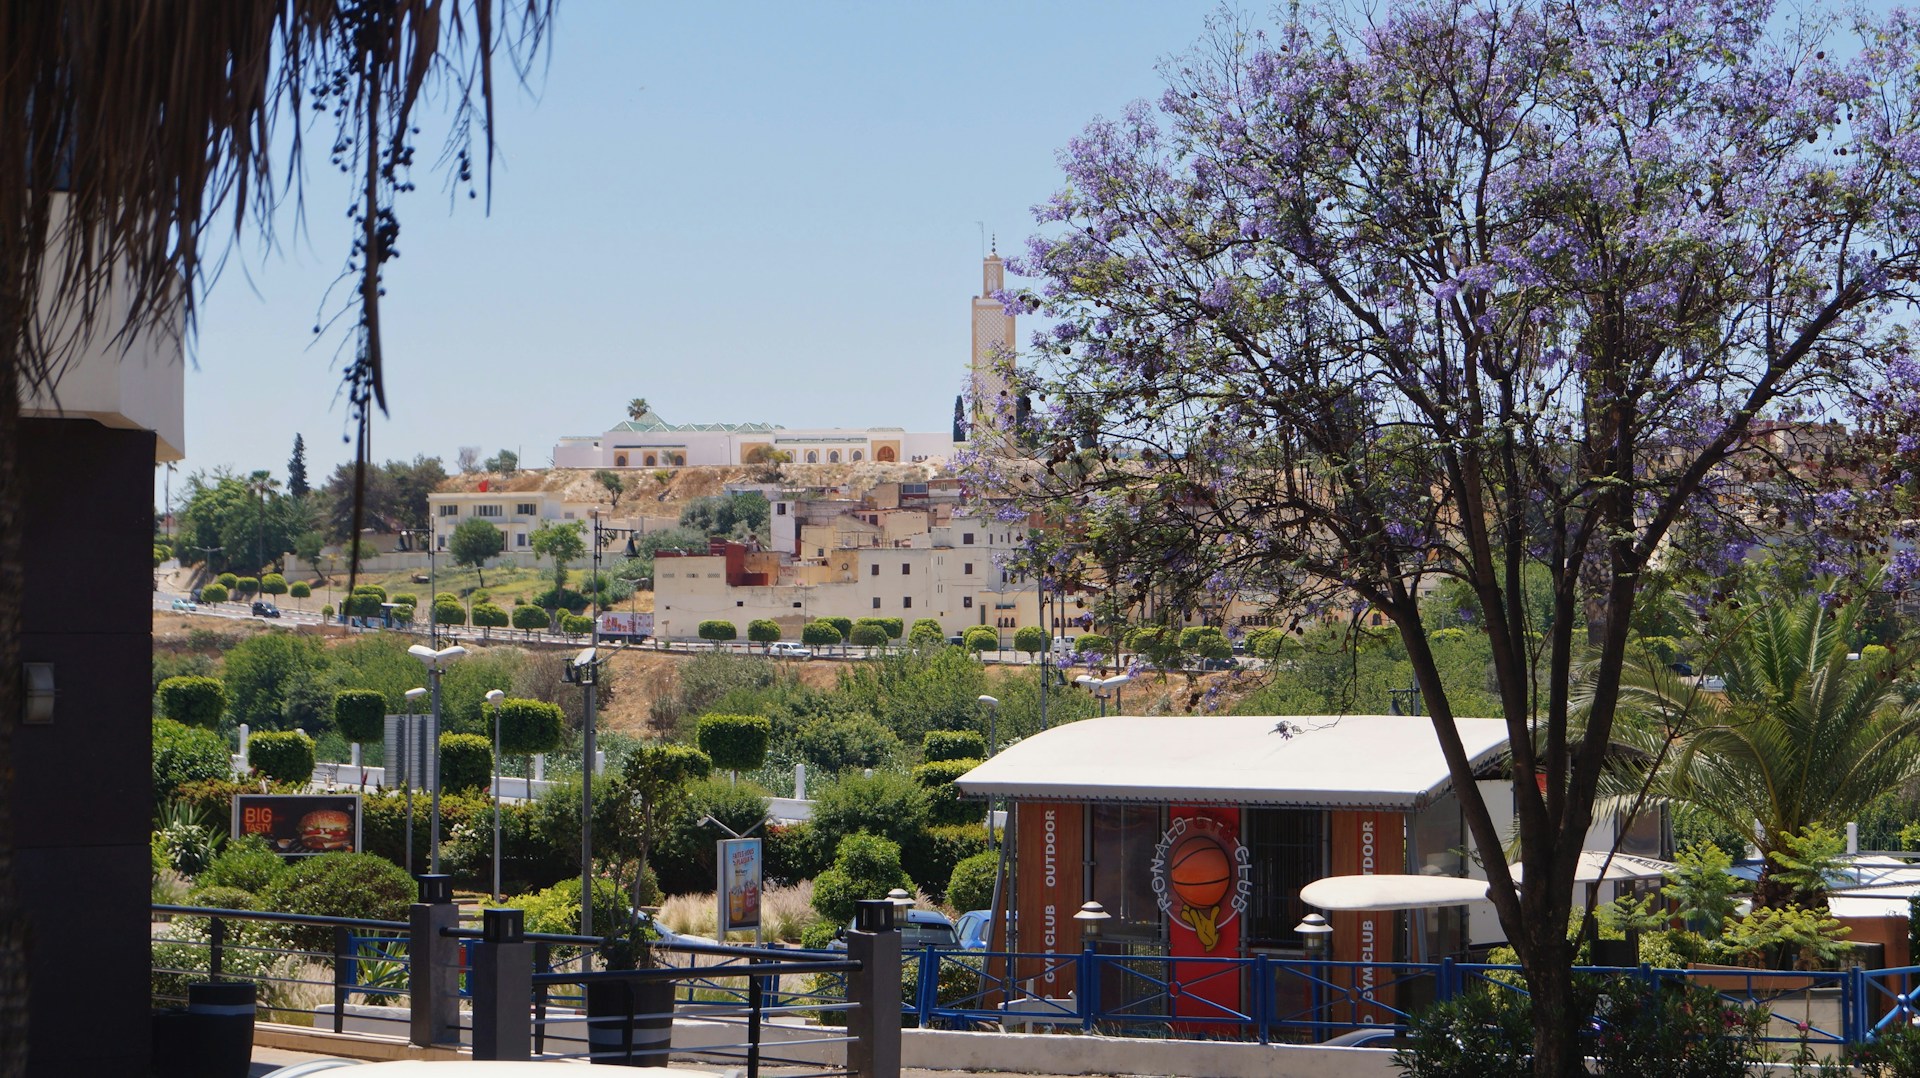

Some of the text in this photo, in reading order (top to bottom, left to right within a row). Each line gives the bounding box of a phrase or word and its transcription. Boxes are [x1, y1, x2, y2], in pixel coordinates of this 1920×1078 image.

[245, 808, 272, 823] BIG
[245, 823, 271, 832] TASTY
[1045, 809, 1056, 887] OUTDOOR
[1150, 817, 1186, 912] RONALD
[1231, 845, 1253, 913] CLUB
[1362, 820, 1374, 875] TDOOR
[1045, 904, 1056, 946] CLUB
[1362, 919, 1374, 963] CLUB
